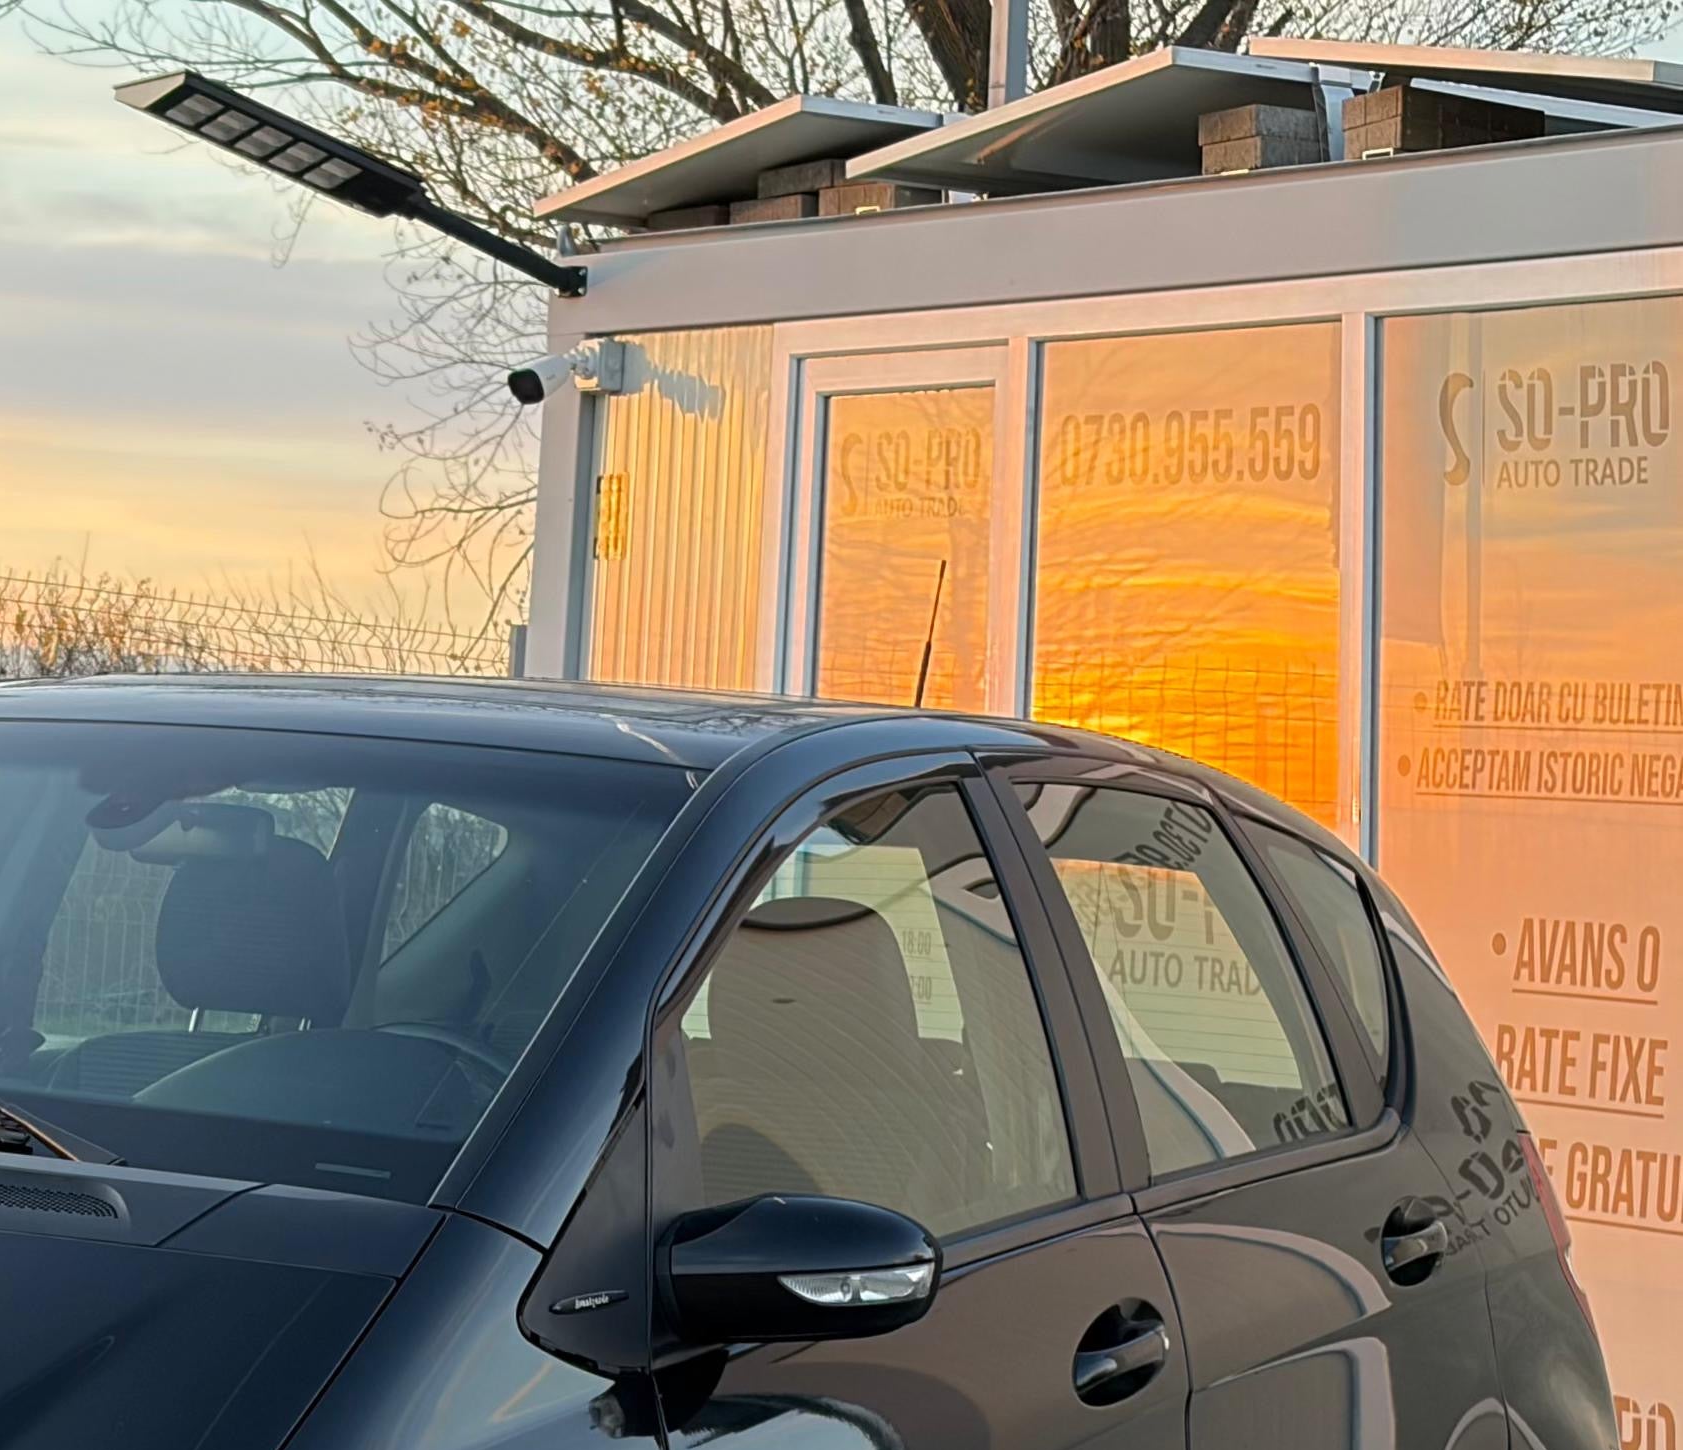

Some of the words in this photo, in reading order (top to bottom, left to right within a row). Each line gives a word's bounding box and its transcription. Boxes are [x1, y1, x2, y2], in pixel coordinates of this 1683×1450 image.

[1496, 361, 1670, 452] SO-PRO
[874, 427, 982, 492] SO-PRO
[1060, 403, 1322, 487] 0730.955.559
[1497, 460, 1561, 489] AUTO
[1570, 456, 1649, 487] TRADE
[1434, 680, 1488, 722] RATE
[1492, 681, 1553, 724] DOAR
[1557, 682, 1587, 724] CU
[1416, 748, 1531, 792] ACCEPTAM
[1536, 751, 1625, 796] ISTORIC
[1109, 949, 1184, 988] AUTO
[1513, 917, 1628, 990] AVANS
[1495, 1023, 1581, 1097] RATE
[1588, 1033, 1668, 1107] FIXE
[1565, 1141, 1683, 1225] GRATU
